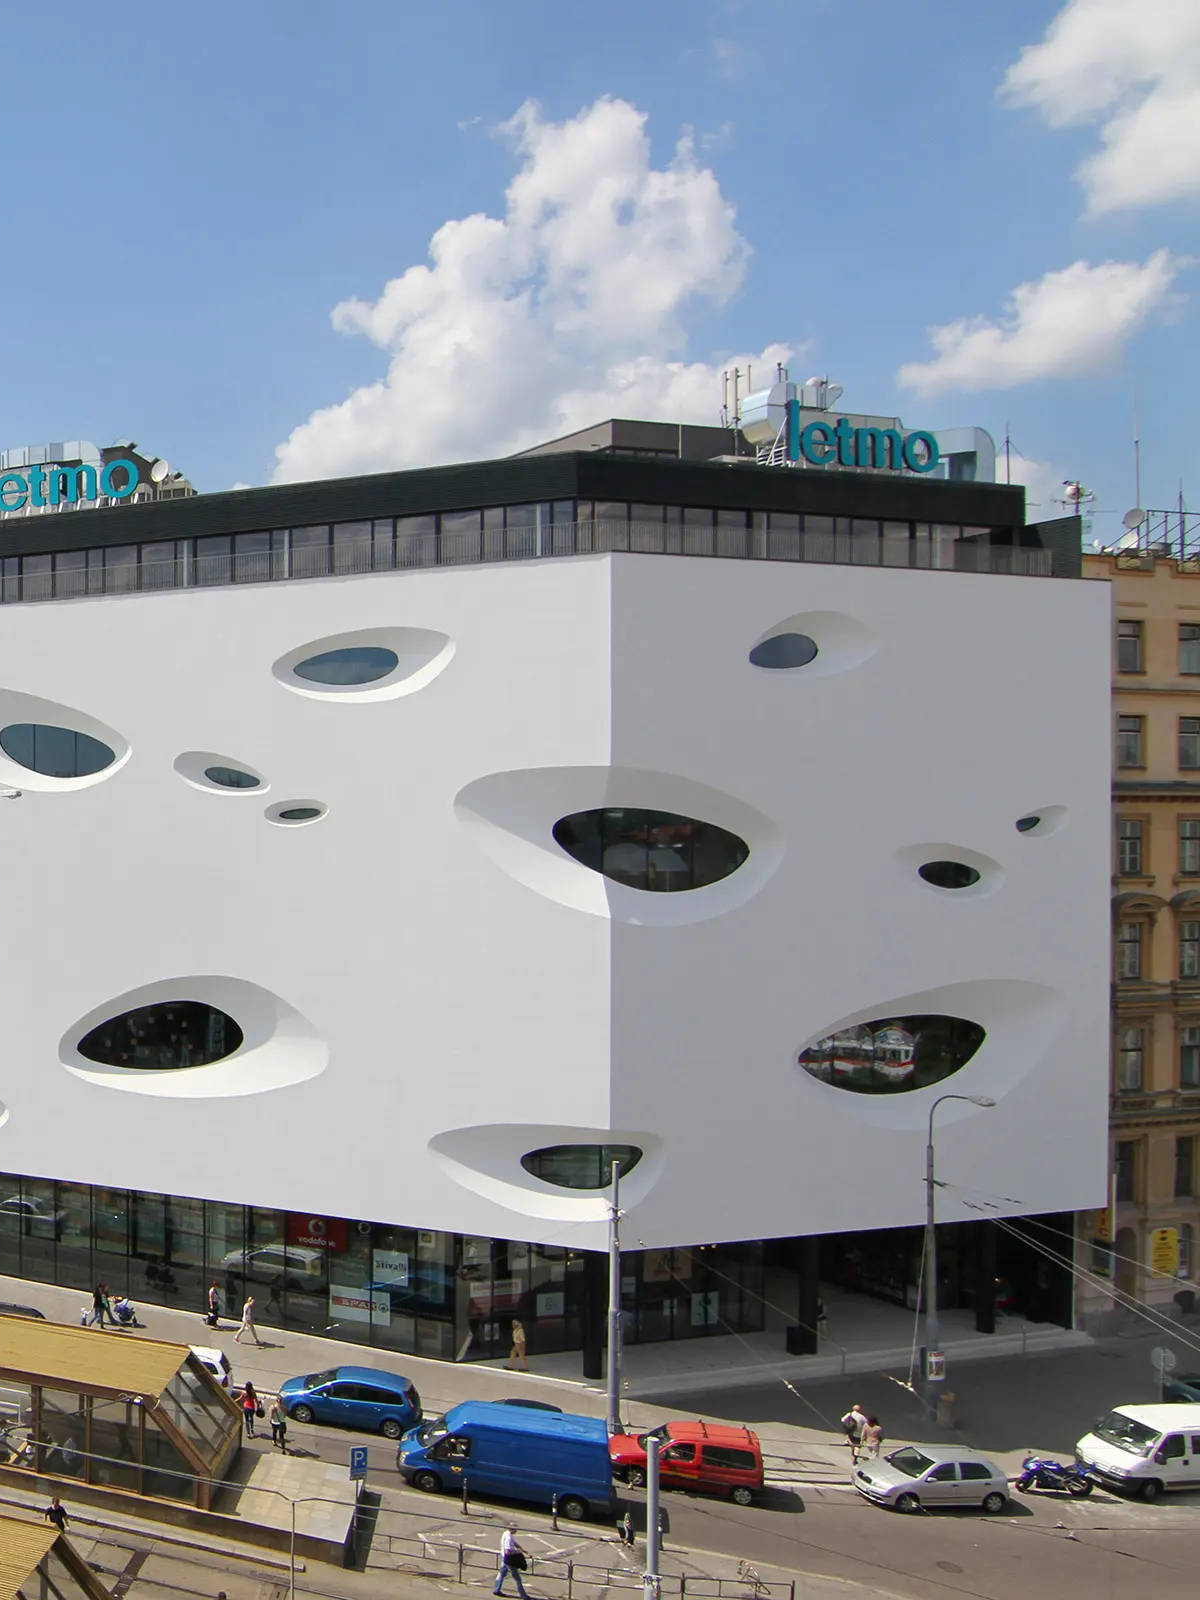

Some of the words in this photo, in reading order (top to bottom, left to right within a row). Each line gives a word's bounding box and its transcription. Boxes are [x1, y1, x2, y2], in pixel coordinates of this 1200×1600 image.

[785, 399, 940, 473] letmo
[298, 1236, 336, 1247] vodafone
[341, 1298, 377, 1311] SPAR
[354, 1450, 365, 1467] P
